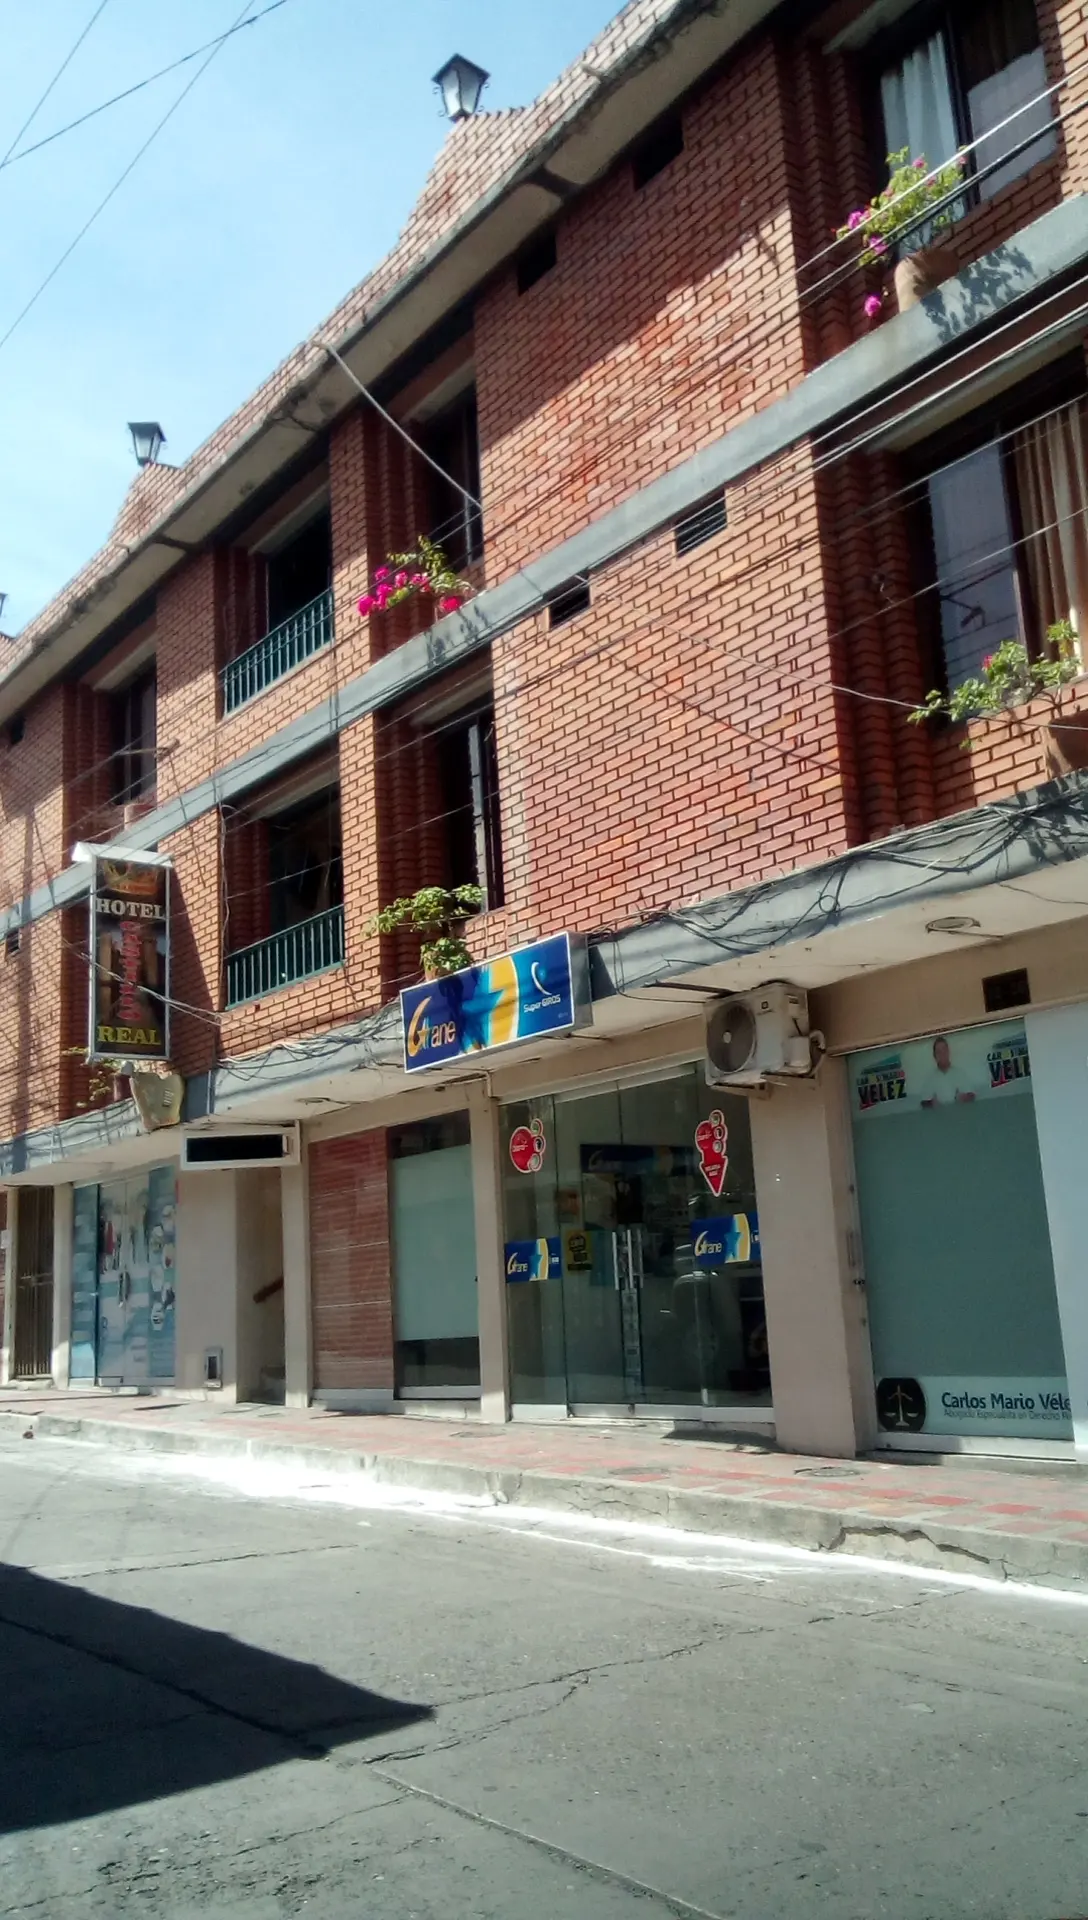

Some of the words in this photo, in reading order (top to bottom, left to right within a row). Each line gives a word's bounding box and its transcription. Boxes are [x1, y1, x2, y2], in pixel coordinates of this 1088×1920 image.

[96, 897, 165, 920] HOTEL
[97, 1026, 162, 1046] REAL
[857, 1078, 908, 1105] VELEZ
[941, 1391, 986, 1409] Carlos
[991, 1392, 1035, 1410] Mario
